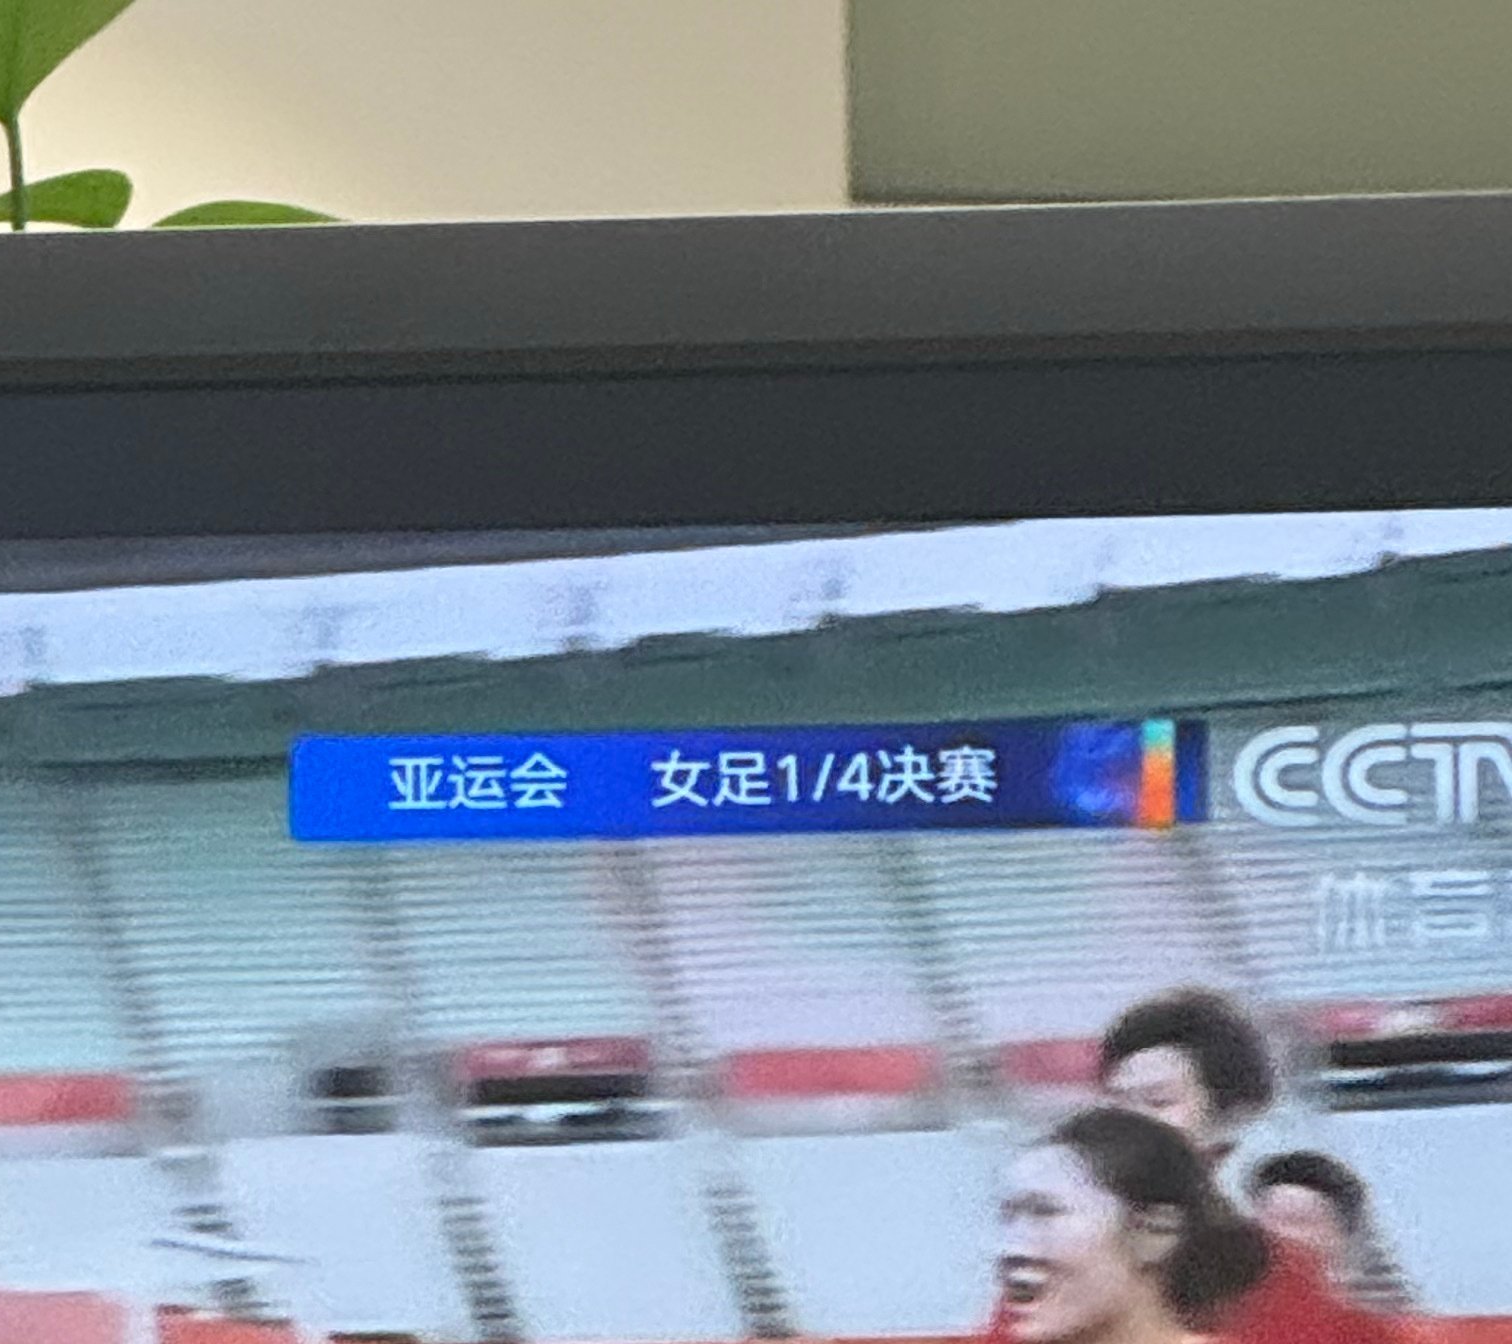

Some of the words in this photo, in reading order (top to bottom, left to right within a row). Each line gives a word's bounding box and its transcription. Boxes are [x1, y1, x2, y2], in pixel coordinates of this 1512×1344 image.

[387, 752, 567, 811] 亚运会
[650, 744, 998, 809] 女足1/4决赛
